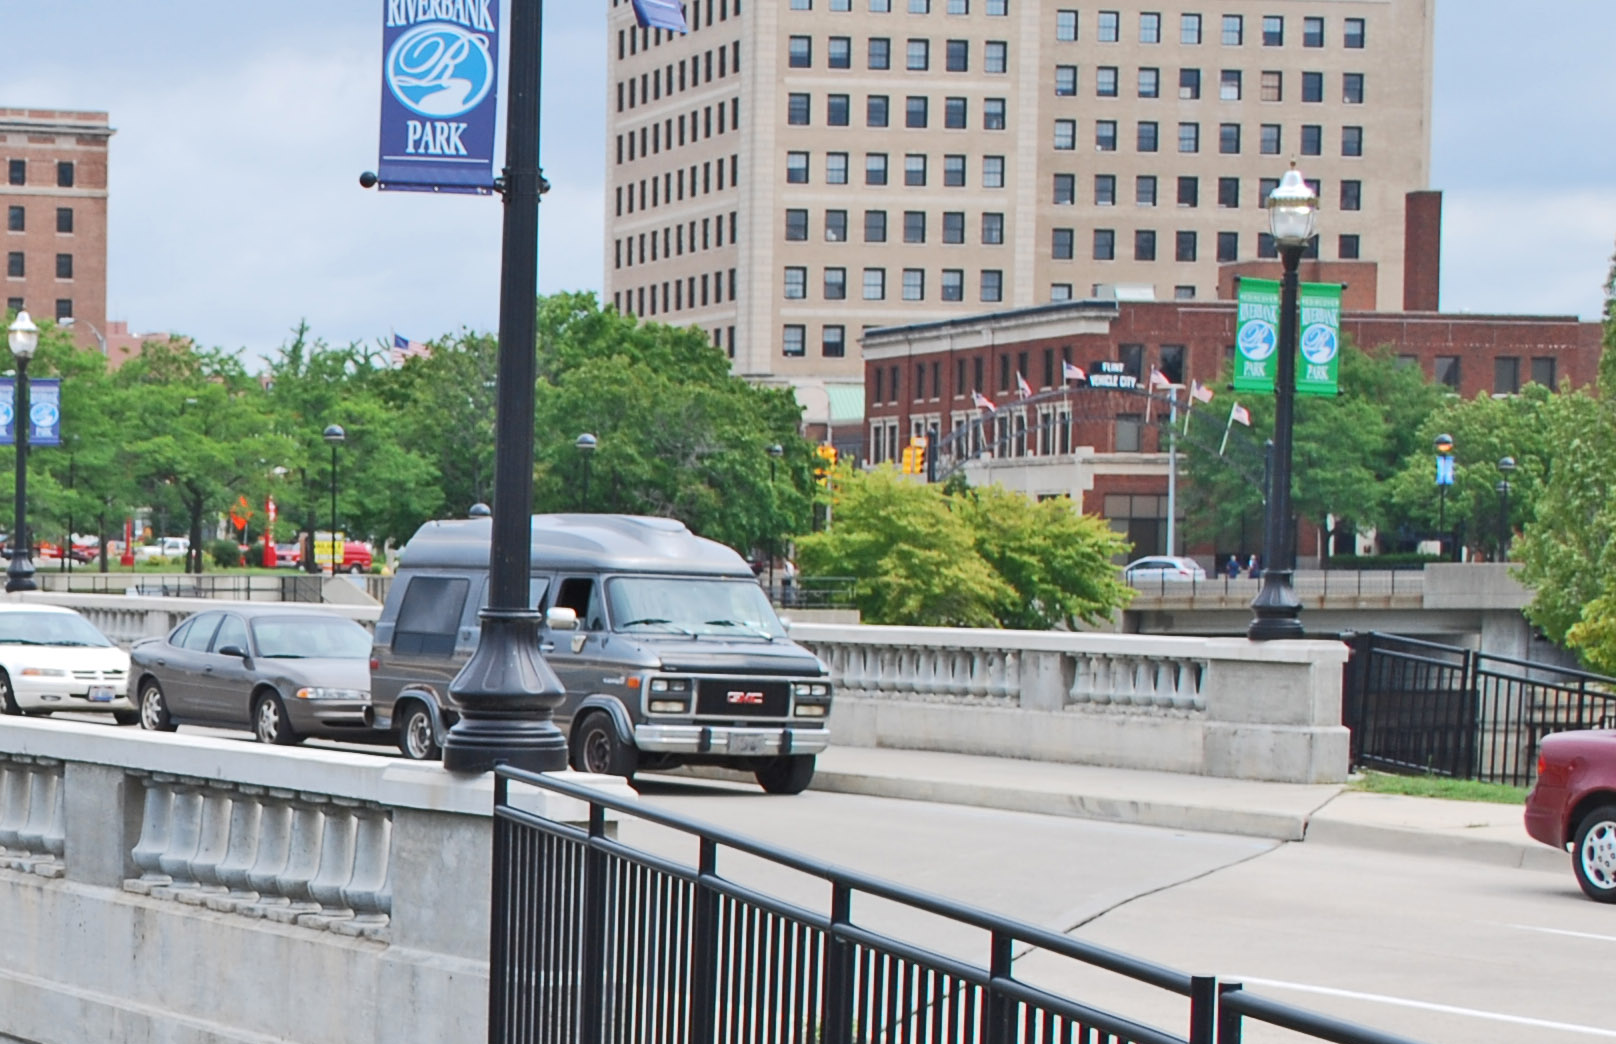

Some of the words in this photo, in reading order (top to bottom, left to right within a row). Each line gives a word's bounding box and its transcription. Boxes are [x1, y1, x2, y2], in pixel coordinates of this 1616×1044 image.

[387, 0, 495, 32] RIVERBANK
[405, 119, 468, 156] PARK
[1101, 361, 1124, 373] FLINT
[1244, 360, 1267, 377] PARK
[1306, 364, 1329, 380] PARK
[1089, 374, 1119, 388] VEHICLE
[1119, 375, 1137, 389] CITY
[727, 691, 763, 704] GMC
